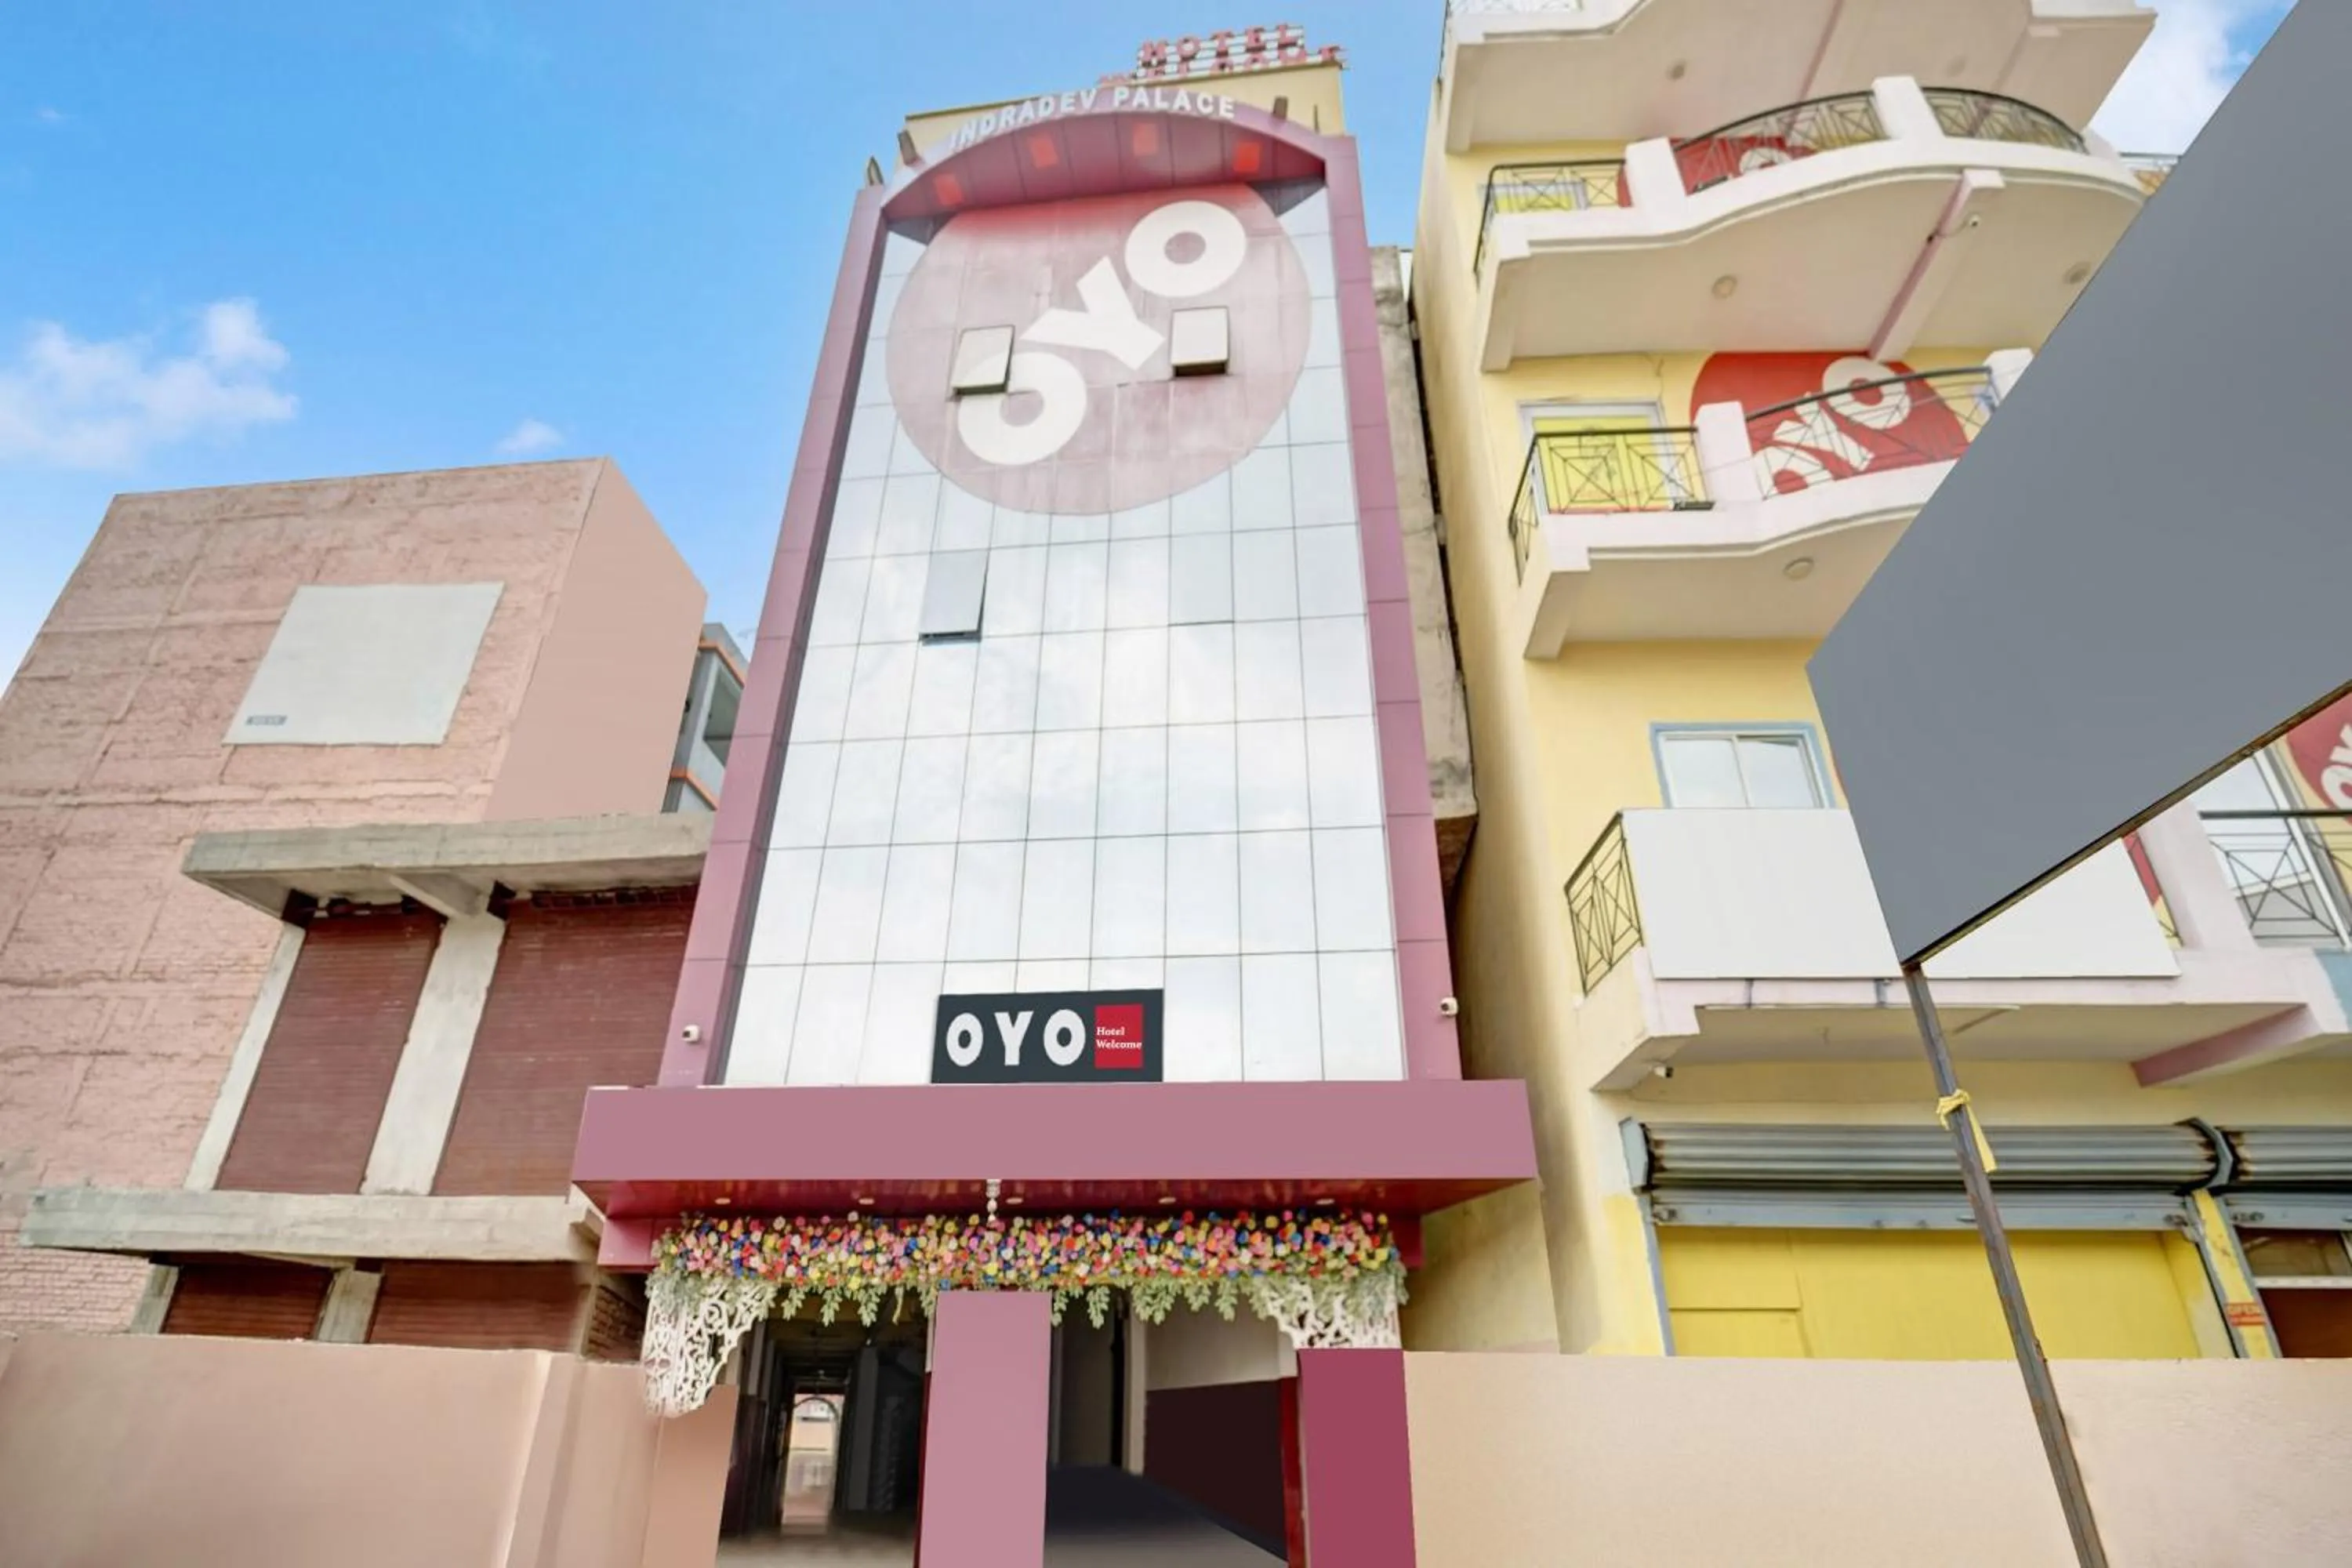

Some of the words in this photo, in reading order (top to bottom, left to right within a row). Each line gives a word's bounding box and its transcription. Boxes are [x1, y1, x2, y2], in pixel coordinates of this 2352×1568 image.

[949, 88, 1097, 151] INDRADEV
[1112, 86, 1236, 119] PALACE
[957, 200, 1247, 465] OYO
[946, 1008, 1086, 1067] OYO
[1095, 1039, 1143, 1050] Welcome
[1096, 1026, 1126, 1036] Hotel
